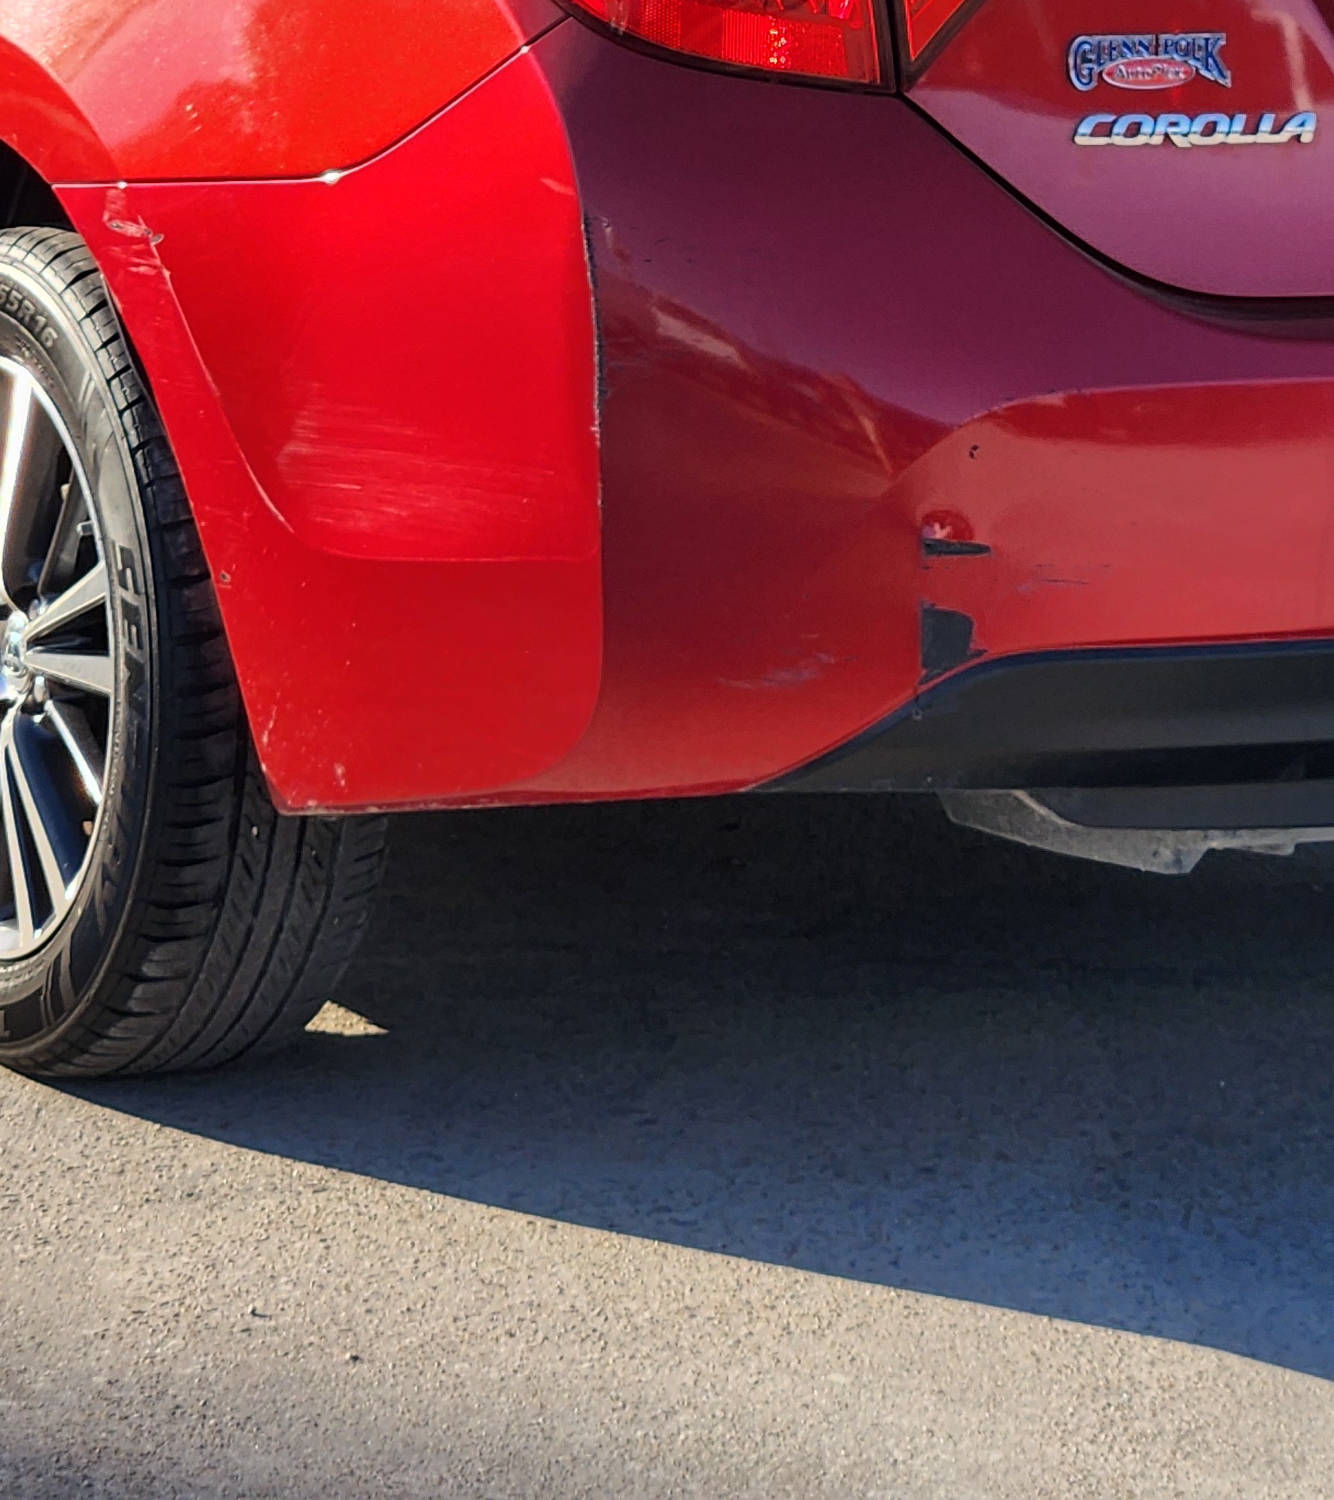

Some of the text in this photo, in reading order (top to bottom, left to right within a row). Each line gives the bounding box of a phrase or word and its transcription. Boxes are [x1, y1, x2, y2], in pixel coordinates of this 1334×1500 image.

[1070, 34, 1231, 89] GLENN POLK
[1073, 111, 1317, 148] COROLLA
